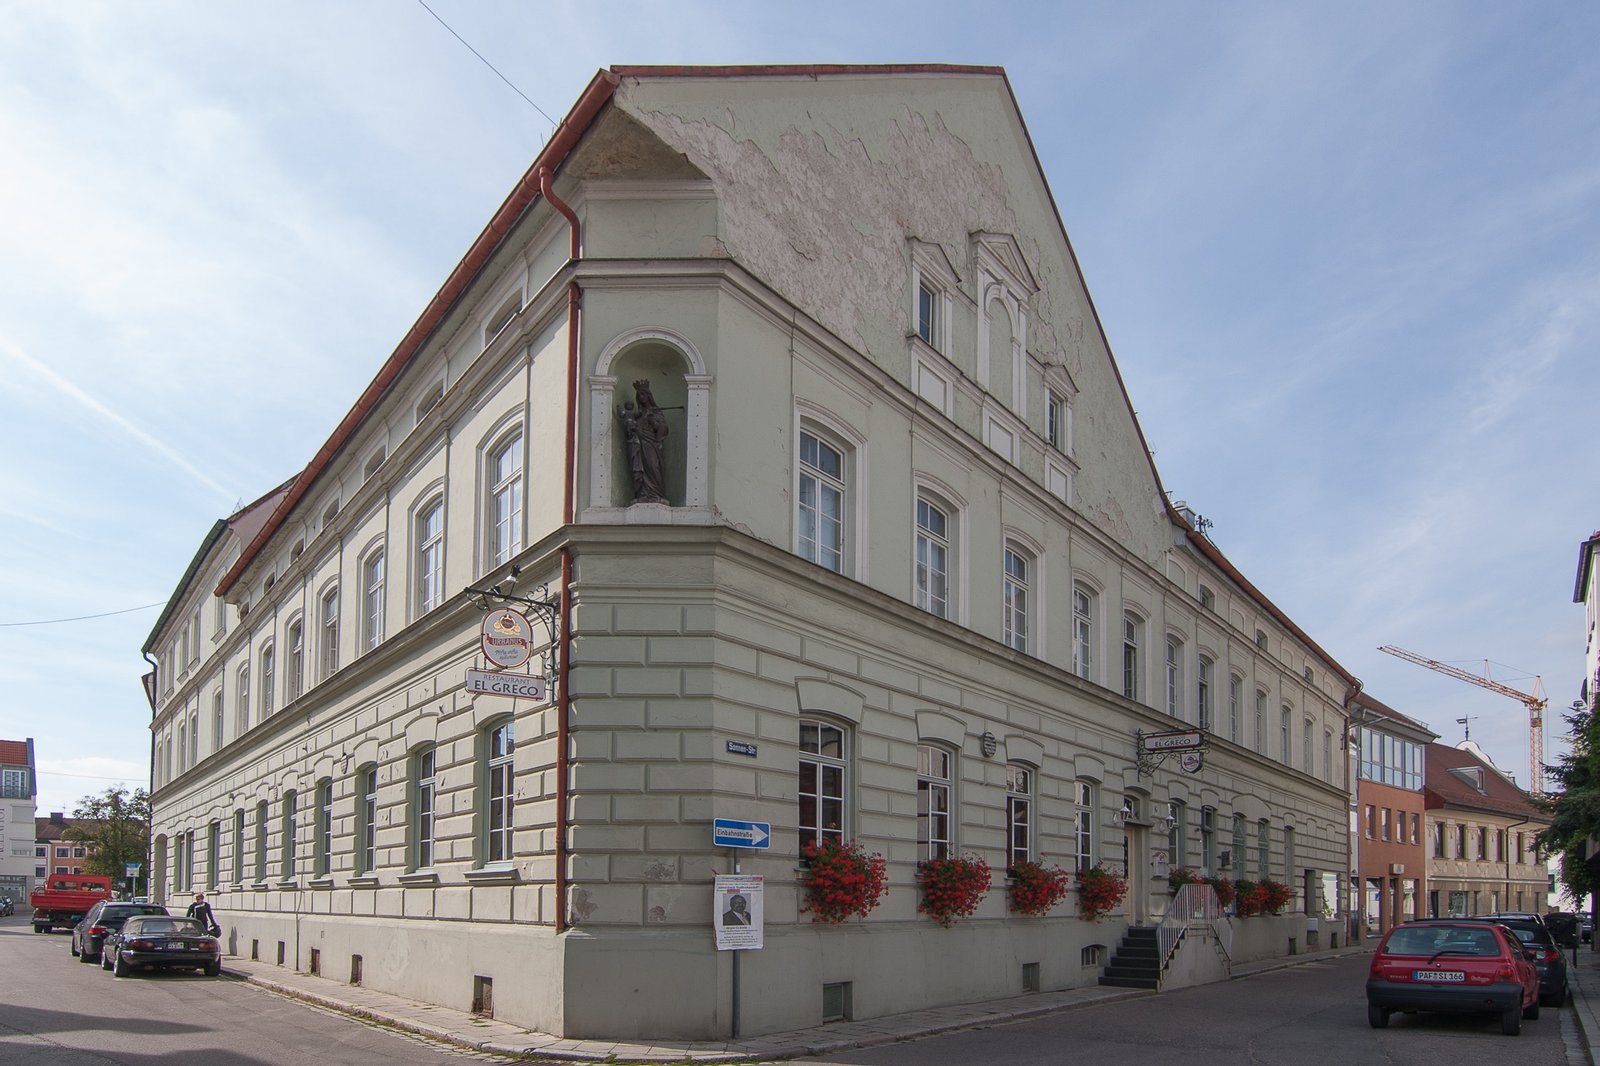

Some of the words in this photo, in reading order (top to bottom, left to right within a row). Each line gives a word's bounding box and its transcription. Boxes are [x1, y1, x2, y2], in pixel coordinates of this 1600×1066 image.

[483, 674, 530, 685] RESTAURANT
[474, 680, 489, 691] EL
[492, 682, 539, 696] GRECO
[1164, 738, 1191, 747] GRECO
[717, 828, 753, 838] Einbahnstraße
